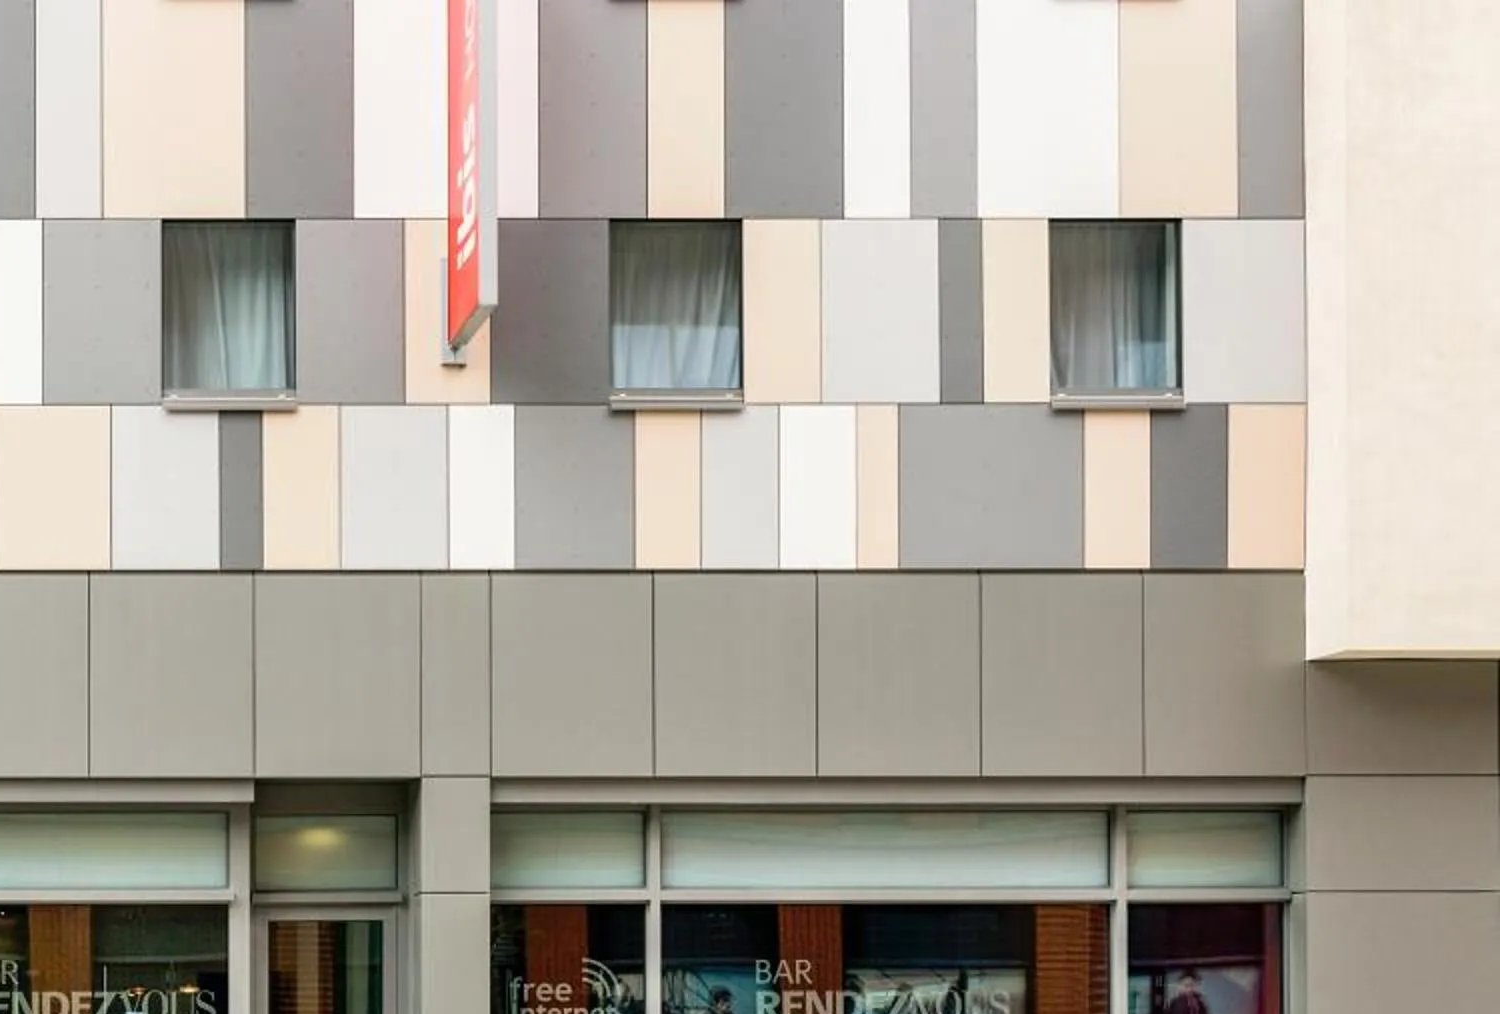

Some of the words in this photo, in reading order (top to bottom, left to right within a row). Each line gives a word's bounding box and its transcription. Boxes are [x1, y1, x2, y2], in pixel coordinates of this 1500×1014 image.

[456, 103, 476, 270] ibis
[755, 959, 812, 984] BAR
[510, 975, 573, 1002] free
